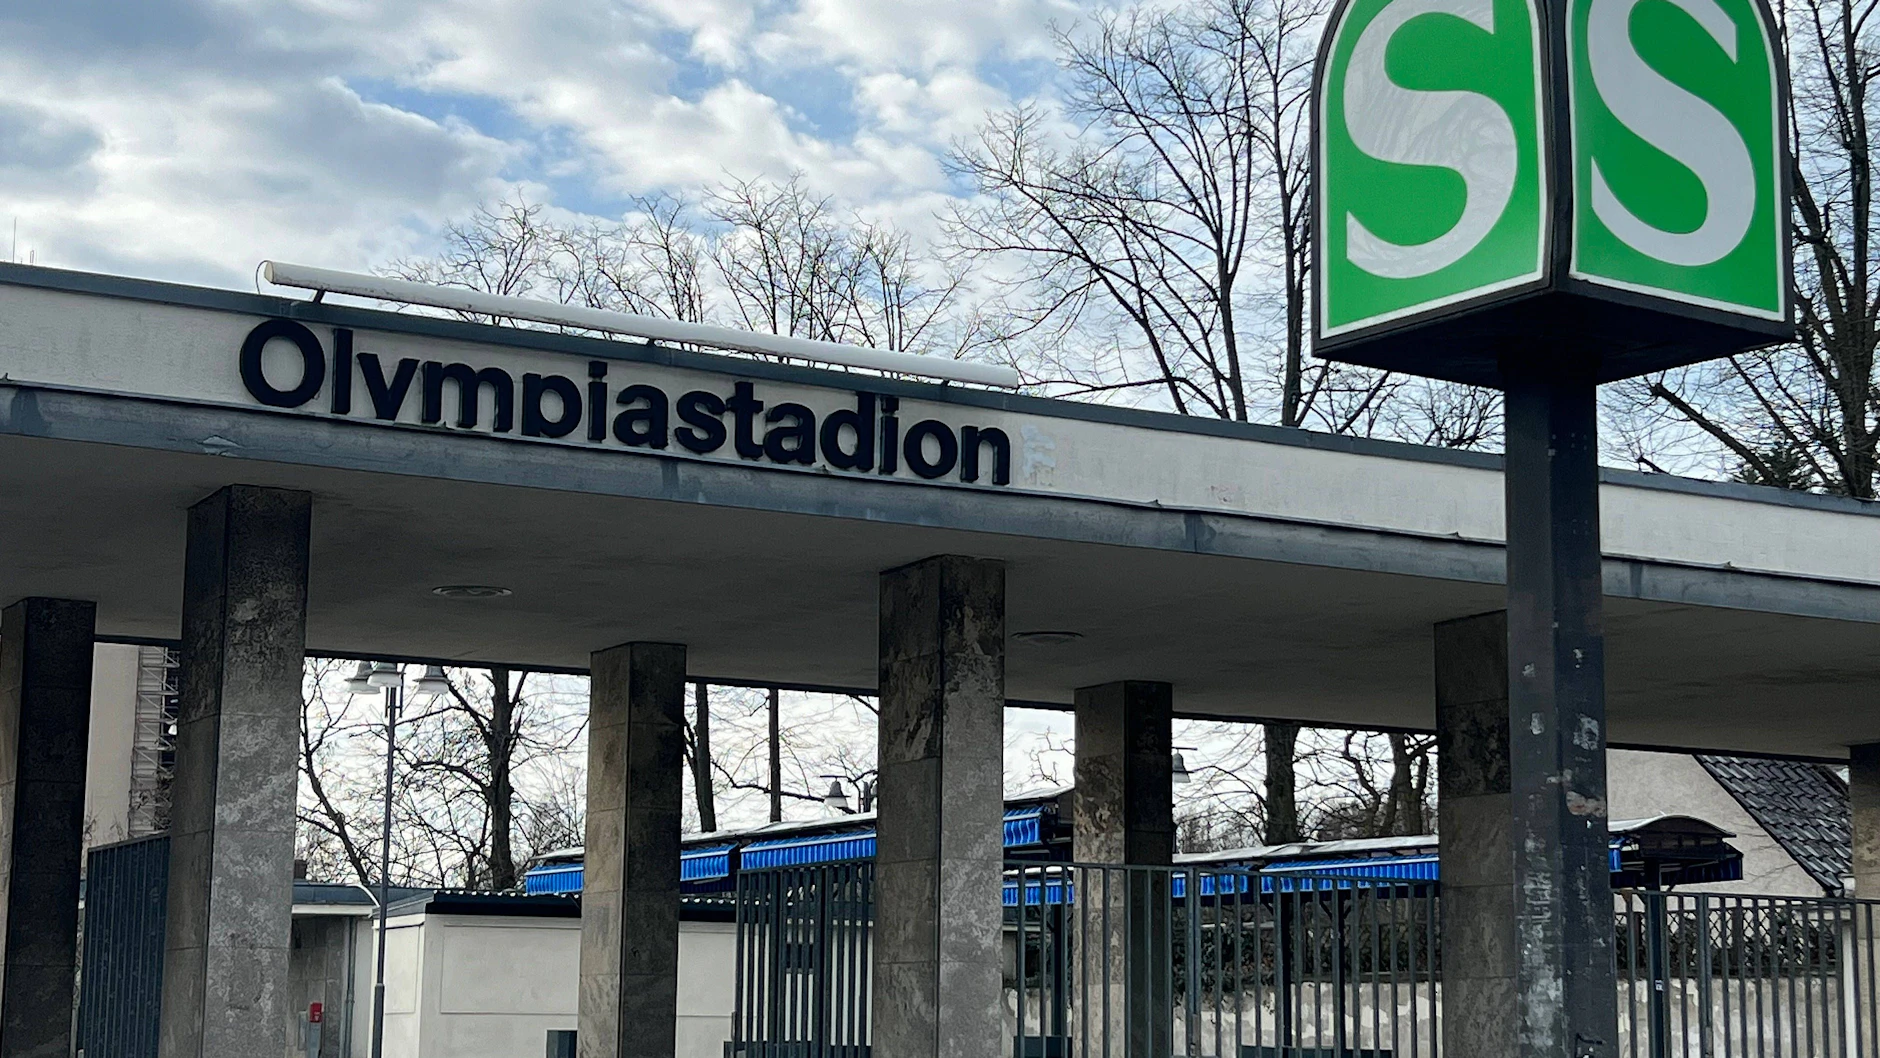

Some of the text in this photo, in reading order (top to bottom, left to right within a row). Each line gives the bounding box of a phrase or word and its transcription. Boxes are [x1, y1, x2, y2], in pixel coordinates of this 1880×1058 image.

[1343, 0, 1517, 279] S
[1587, 0, 1756, 266] S
[240, 318, 1011, 486] Olympiastadion
